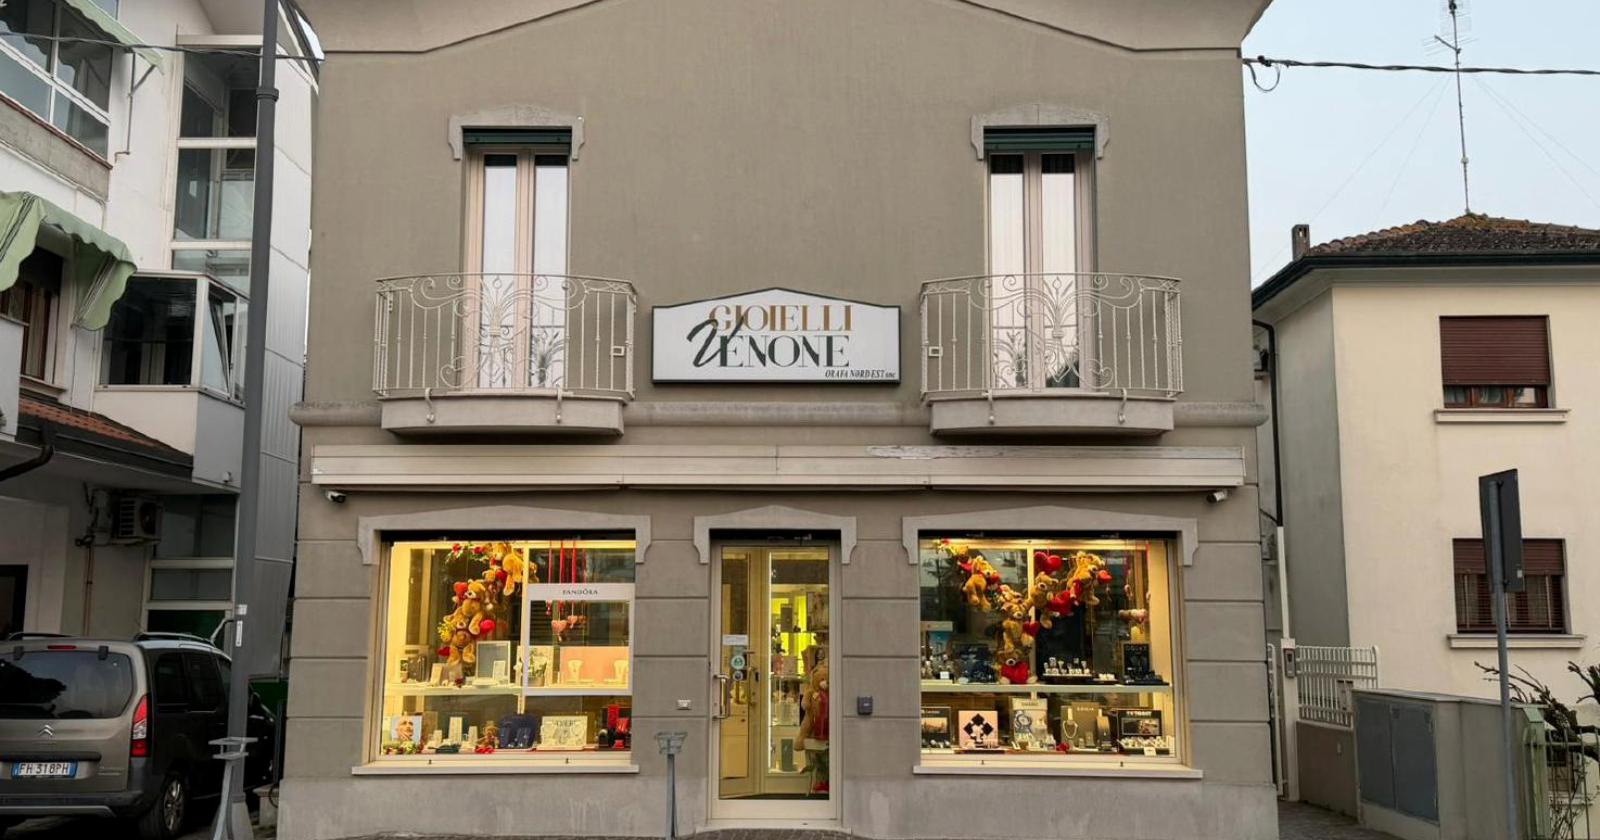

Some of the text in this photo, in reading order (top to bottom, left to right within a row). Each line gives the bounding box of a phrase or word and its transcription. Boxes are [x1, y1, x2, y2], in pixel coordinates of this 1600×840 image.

[708, 305, 853, 331] GIOIELLI
[686, 318, 850, 368] VENONE
[20, 763, 33, 774] FH
